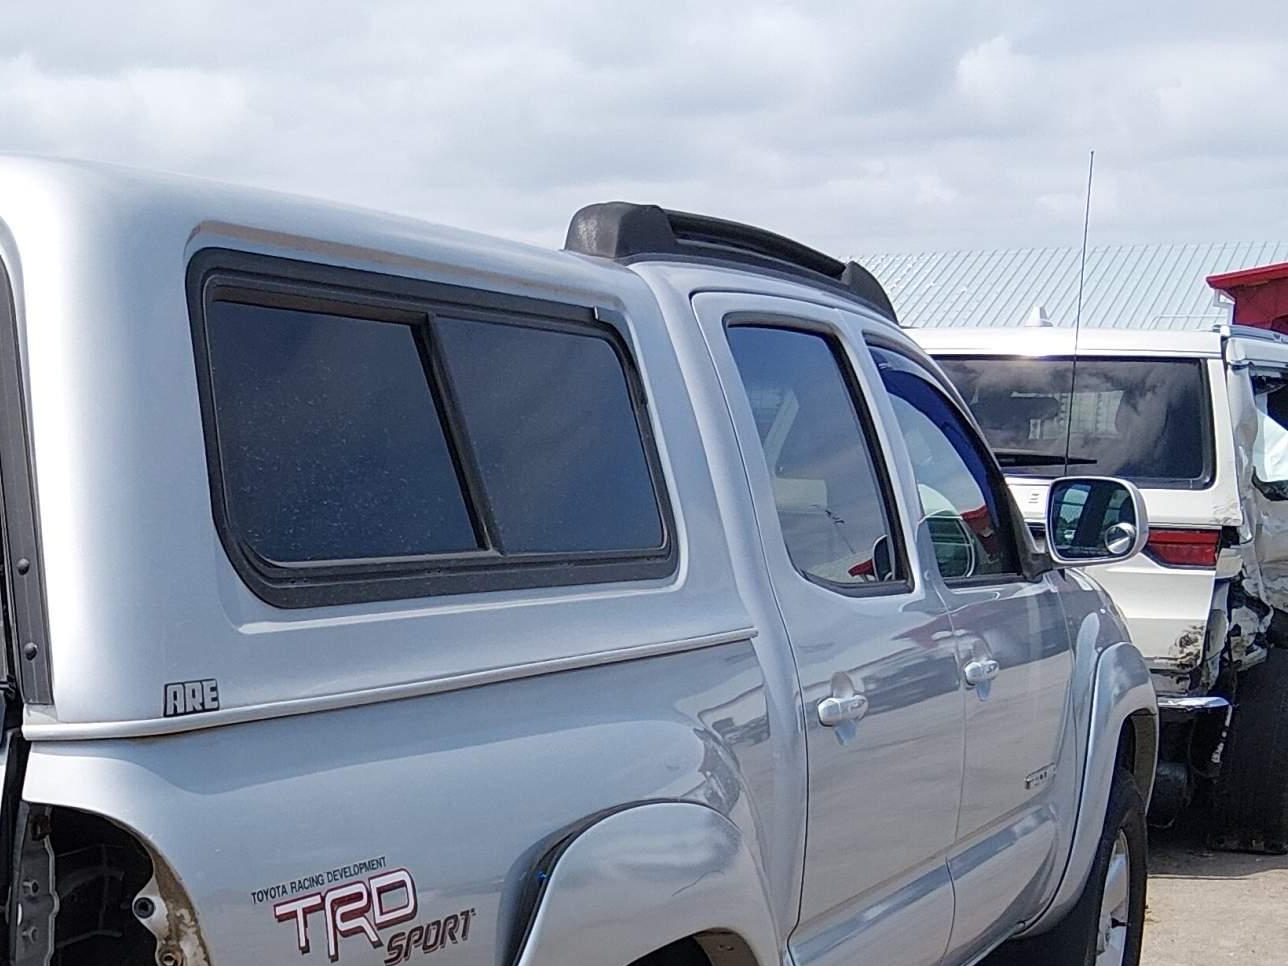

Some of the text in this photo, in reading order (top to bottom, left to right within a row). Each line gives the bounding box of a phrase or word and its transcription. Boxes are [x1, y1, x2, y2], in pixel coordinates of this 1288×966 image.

[164, 679, 219, 717] ARE
[250, 857, 387, 905] TOYOTA RACING DEVELOPMENT
[273, 867, 418, 964] TRD
